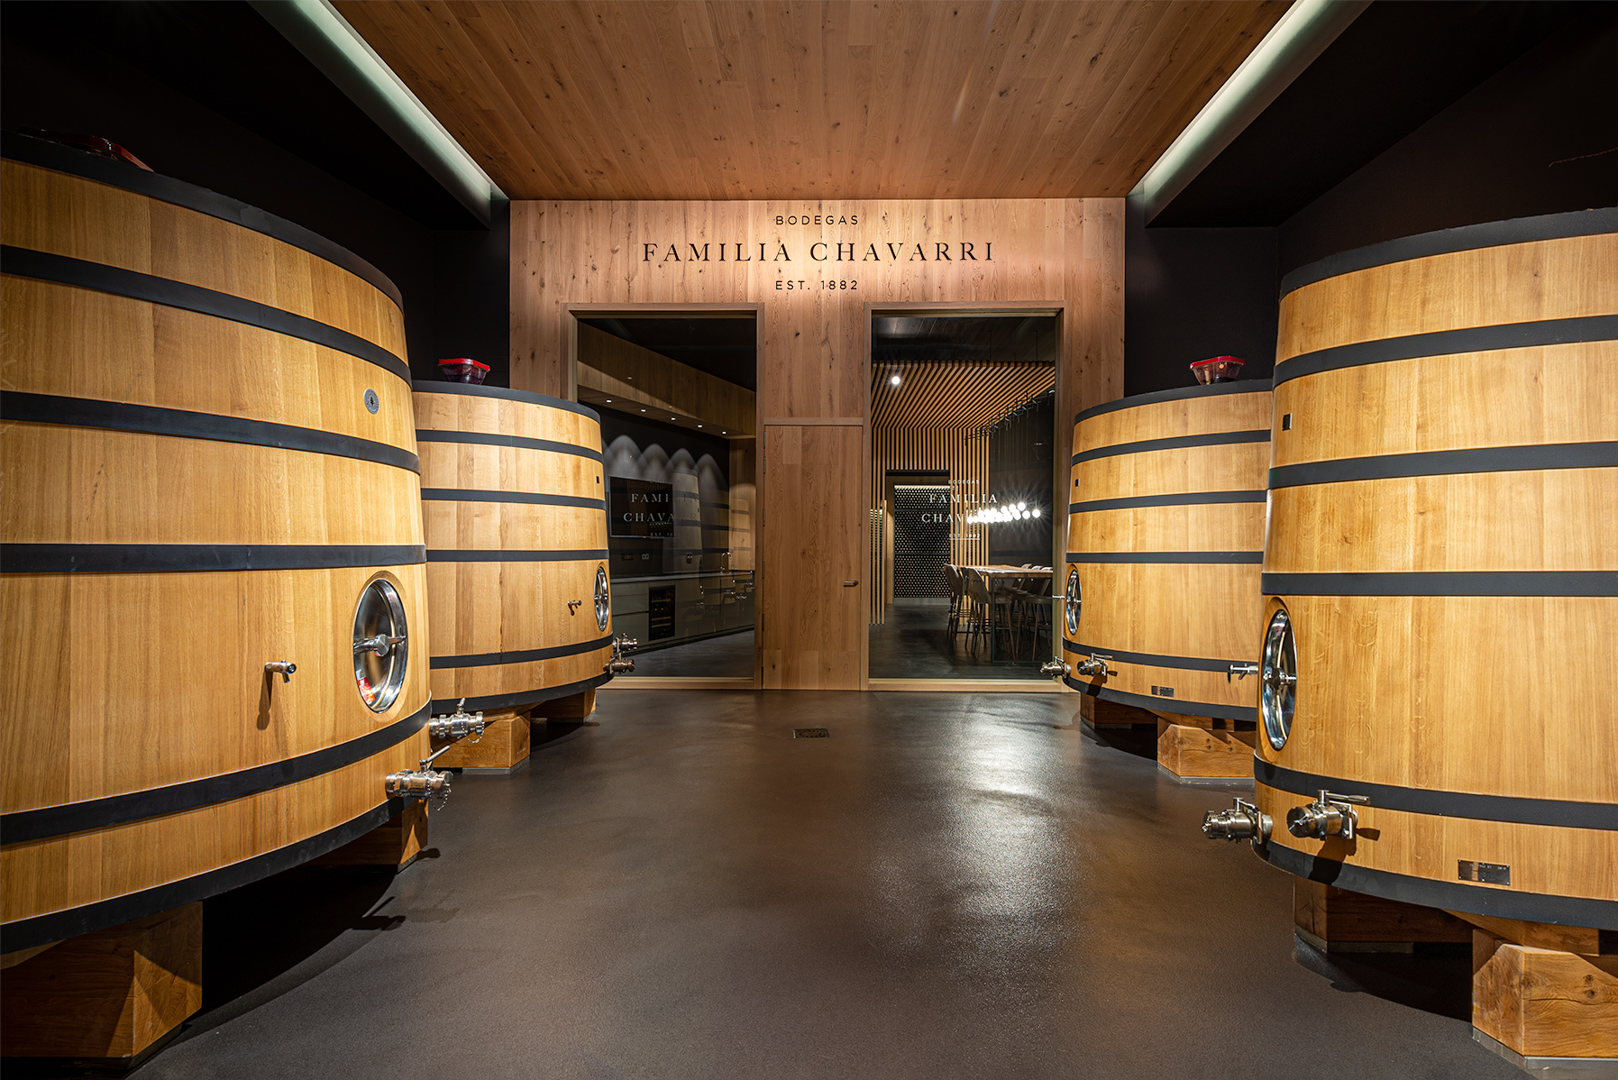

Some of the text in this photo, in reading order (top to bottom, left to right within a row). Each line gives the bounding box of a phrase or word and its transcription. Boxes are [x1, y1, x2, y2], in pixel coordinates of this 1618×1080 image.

[775, 215, 859, 226] BODEGAS
[643, 242, 993, 262] FAMILIA CHAVARRI
[775, 280, 859, 290] EST. 1882
[631, 493, 698, 503] FAMIIA
[929, 493, 998, 503] FAMILIA
